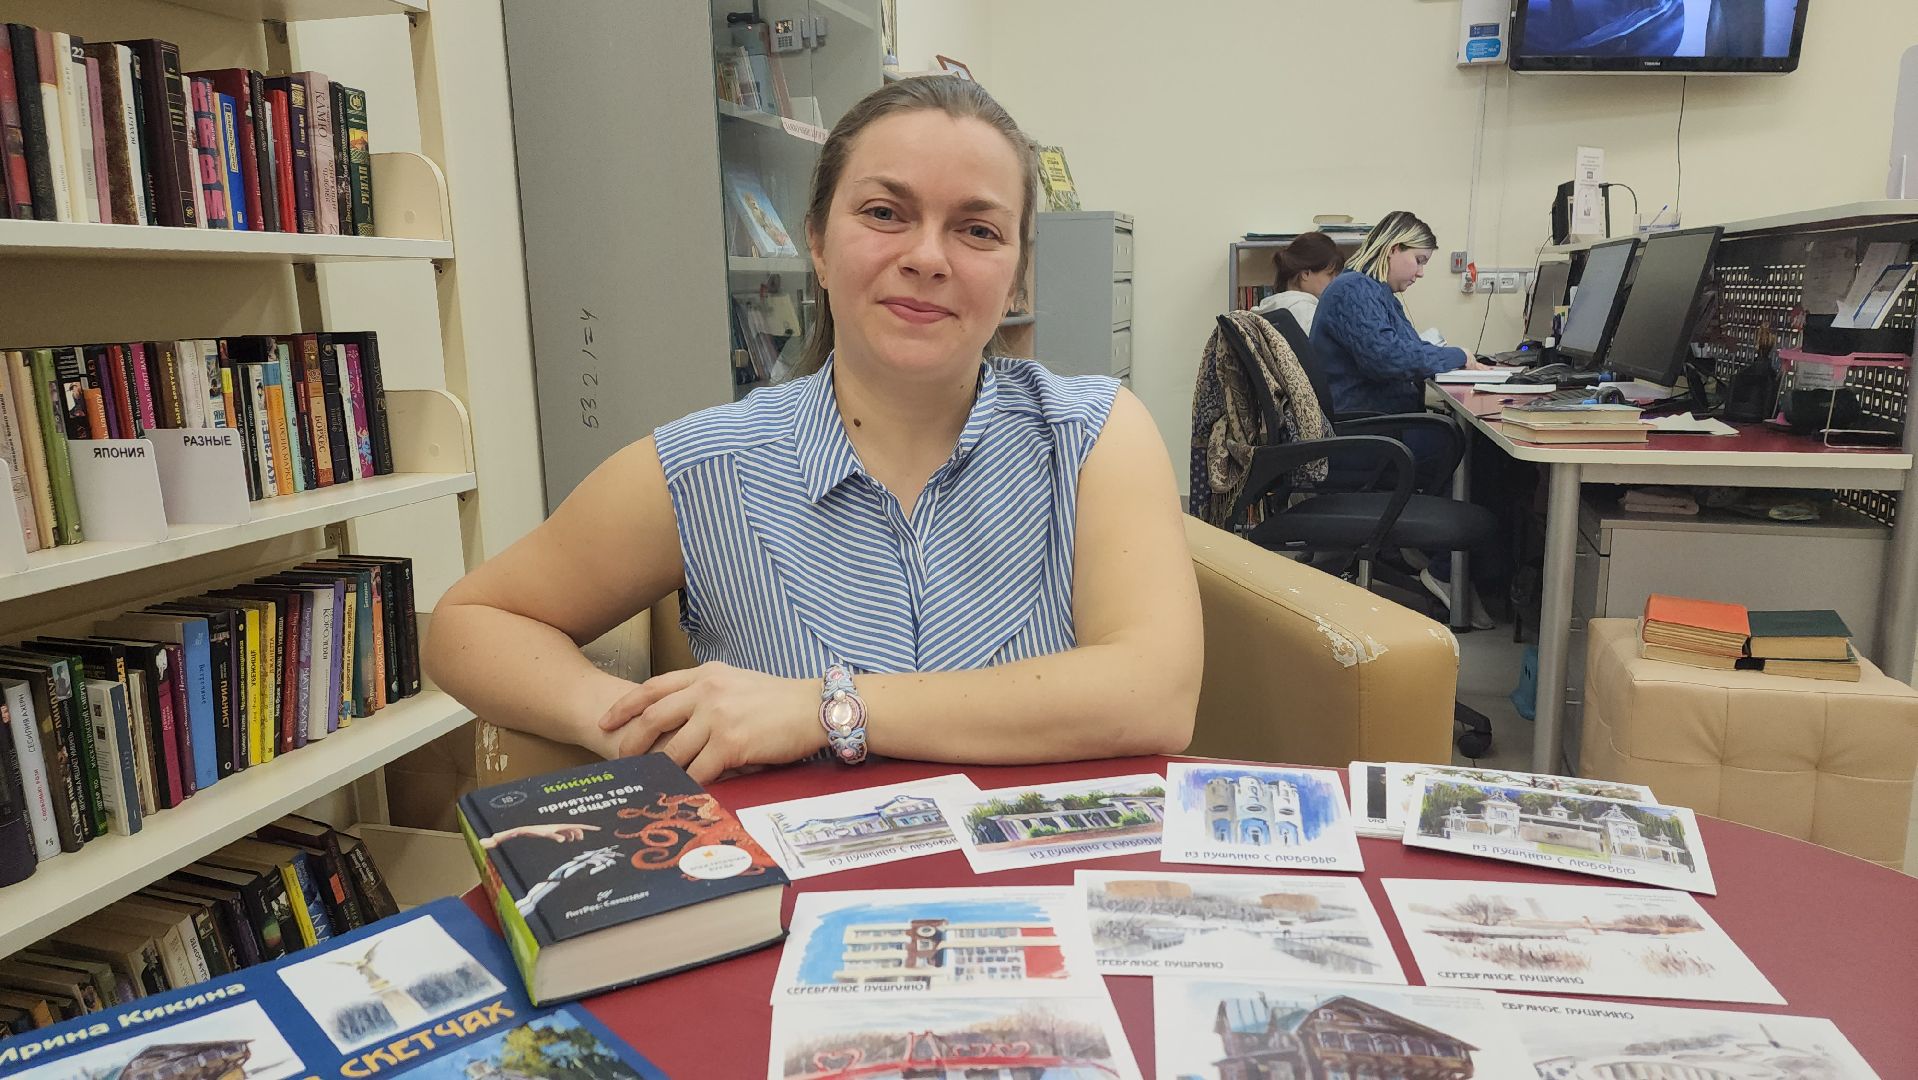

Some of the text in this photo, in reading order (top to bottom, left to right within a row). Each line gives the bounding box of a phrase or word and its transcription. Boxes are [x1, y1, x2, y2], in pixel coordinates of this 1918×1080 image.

[314, 90, 328, 138] КАМЮ
[183, 435, 232, 447] РАЗНЫЕ
[315, 415, 326, 453] БОРХЕС
[93, 447, 146, 459] ЯПОНИЯ
[47, 675, 62, 729] ЛИНДАУТ
[220, 680, 230, 729] ПИАНИСТ
[299, 667, 310, 738] МАТА ХАРИ
[17, 693, 36, 753] СЕСИЛИЯ АХЕРН
[79, 681, 97, 769] МАСКА КРАСНОЙ СМЕРТИ
[543, 772, 615, 794] кикина
[537, 784, 644, 815] приятно тебя
[568, 798, 628, 816] общать
[846, 847, 897, 864] ПУШКИНО
[910, 836, 959, 851] ЛЮБОВЬ
[1031, 850, 1044, 859] ИЗ
[1047, 843, 1100, 858] ПУШКИНО
[1112, 836, 1162, 849] ЛЮБОВЬ
[1203, 851, 1260, 861] ПУШКИНО
[1264, 854, 1271, 862] С
[1275, 854, 1337, 864] ЛЮБОВЬЮ
[1472, 843, 1636, 875] ИЗ ПУШКИНО С ЛЮБОВЬЮ
[1097, 959, 1224, 969] ЕРЕБРЯНОЕ ПУШКИНО
[864, 983, 925, 992] ПУШКИНО
[1520, 974, 1585, 985] ПУШКИНО
[0, 983, 246, 1066] Ирина Кикина
[1502, 1002, 1635, 1020] ЕБРЯНОЕ ПУШКИНО
[339, 1000, 515, 1078] СКЕТЧАХ
